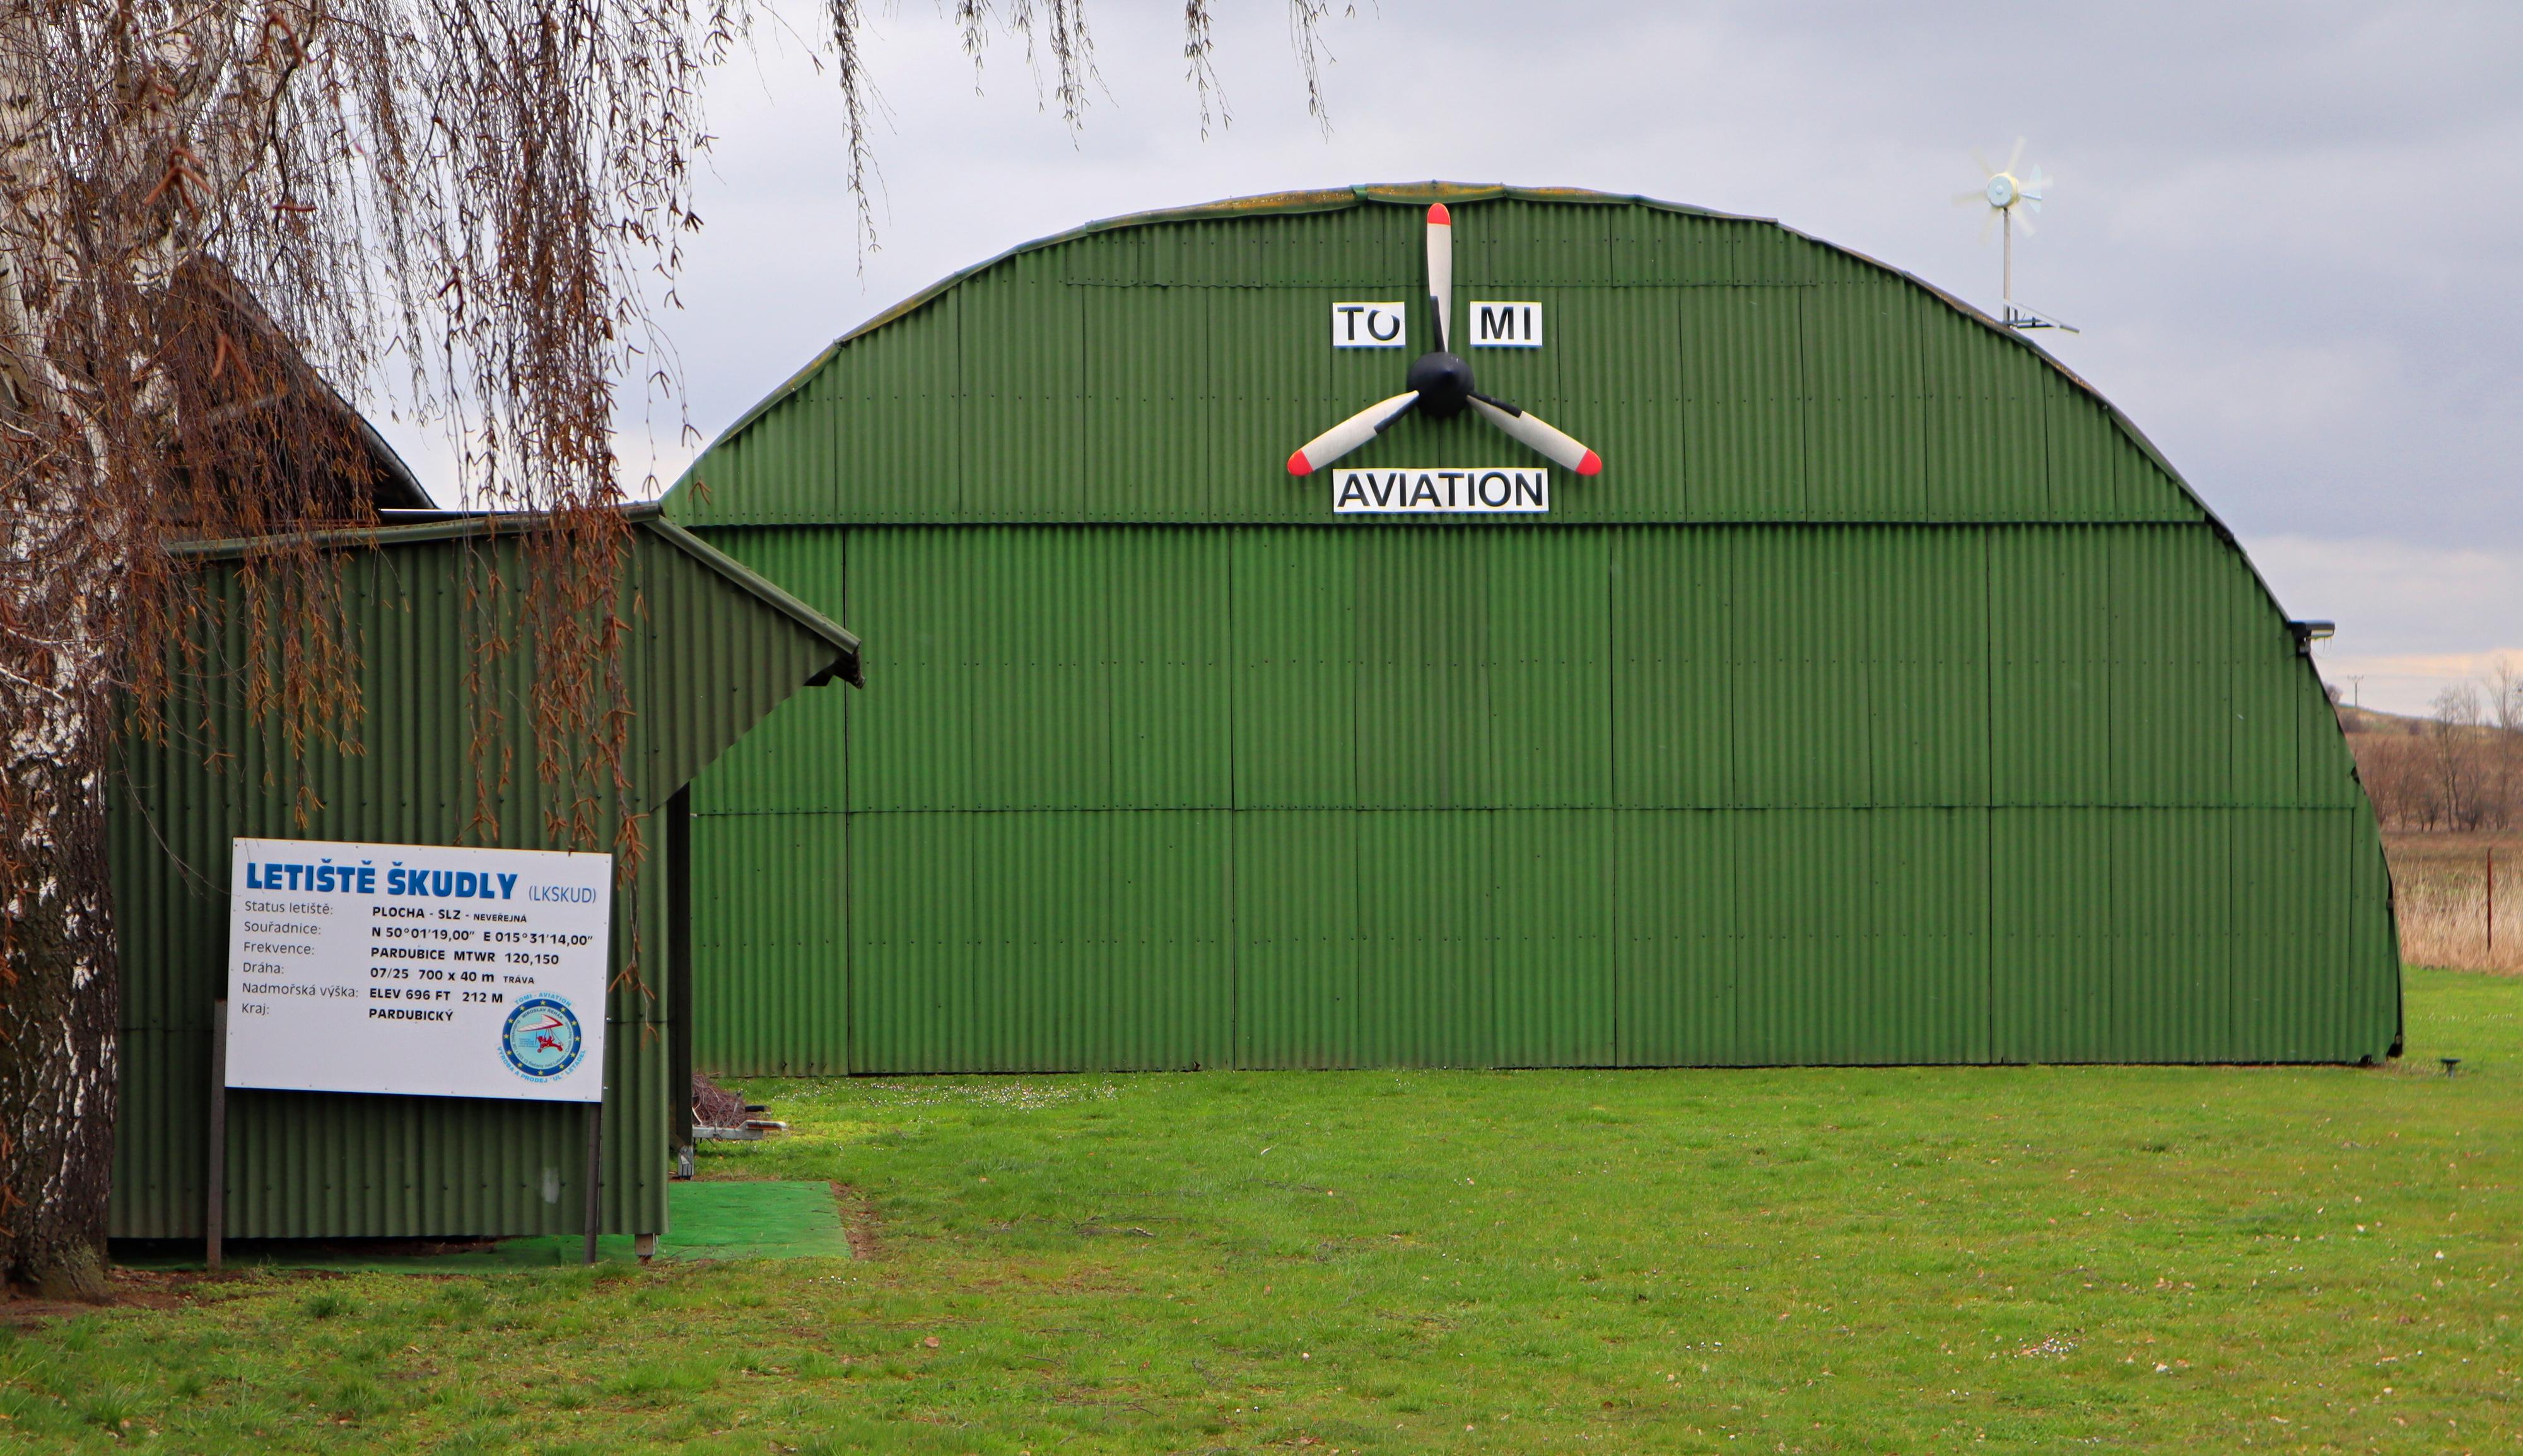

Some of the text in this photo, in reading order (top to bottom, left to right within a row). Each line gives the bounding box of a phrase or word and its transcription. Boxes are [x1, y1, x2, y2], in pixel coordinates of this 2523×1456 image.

[1337, 306, 1531, 341] TO MI
[1337, 472, 1543, 508] AVIATION
[247, 858, 596, 904] LETIŠTĚ ŠKUDLY (LKSKUD)
[245, 900, 284, 913] Status
[290, 902, 333, 915] letiště:
[373, 907, 424, 918] PLOCHA
[438, 909, 460, 920] SLZ
[474, 912, 527, 923] NEVEŘEJNÁ
[244, 921, 322, 935] Souřadnice:
[372, 927, 380, 937] N
[484, 931, 491, 941] E
[243, 941, 559, 965] Frekvence: PARDUBICE MTWR 120,150
[243, 962, 534, 984] Dráha: 07/25 700 x 40 m TRÁVA
[242, 982, 503, 1003] Nadmořská výška: ELEV 696 FT 212 M
[514, 993, 533, 1005] TOMI
[539, 992, 572, 1008] AVIATION
[242, 1003, 453, 1021] Kraj: PARDUBICKÝ
[522, 1008, 546, 1019] MIROSLAV
[520, 1073, 548, 1083] PRODEJ
[565, 1049, 587, 1075] LETADEL
